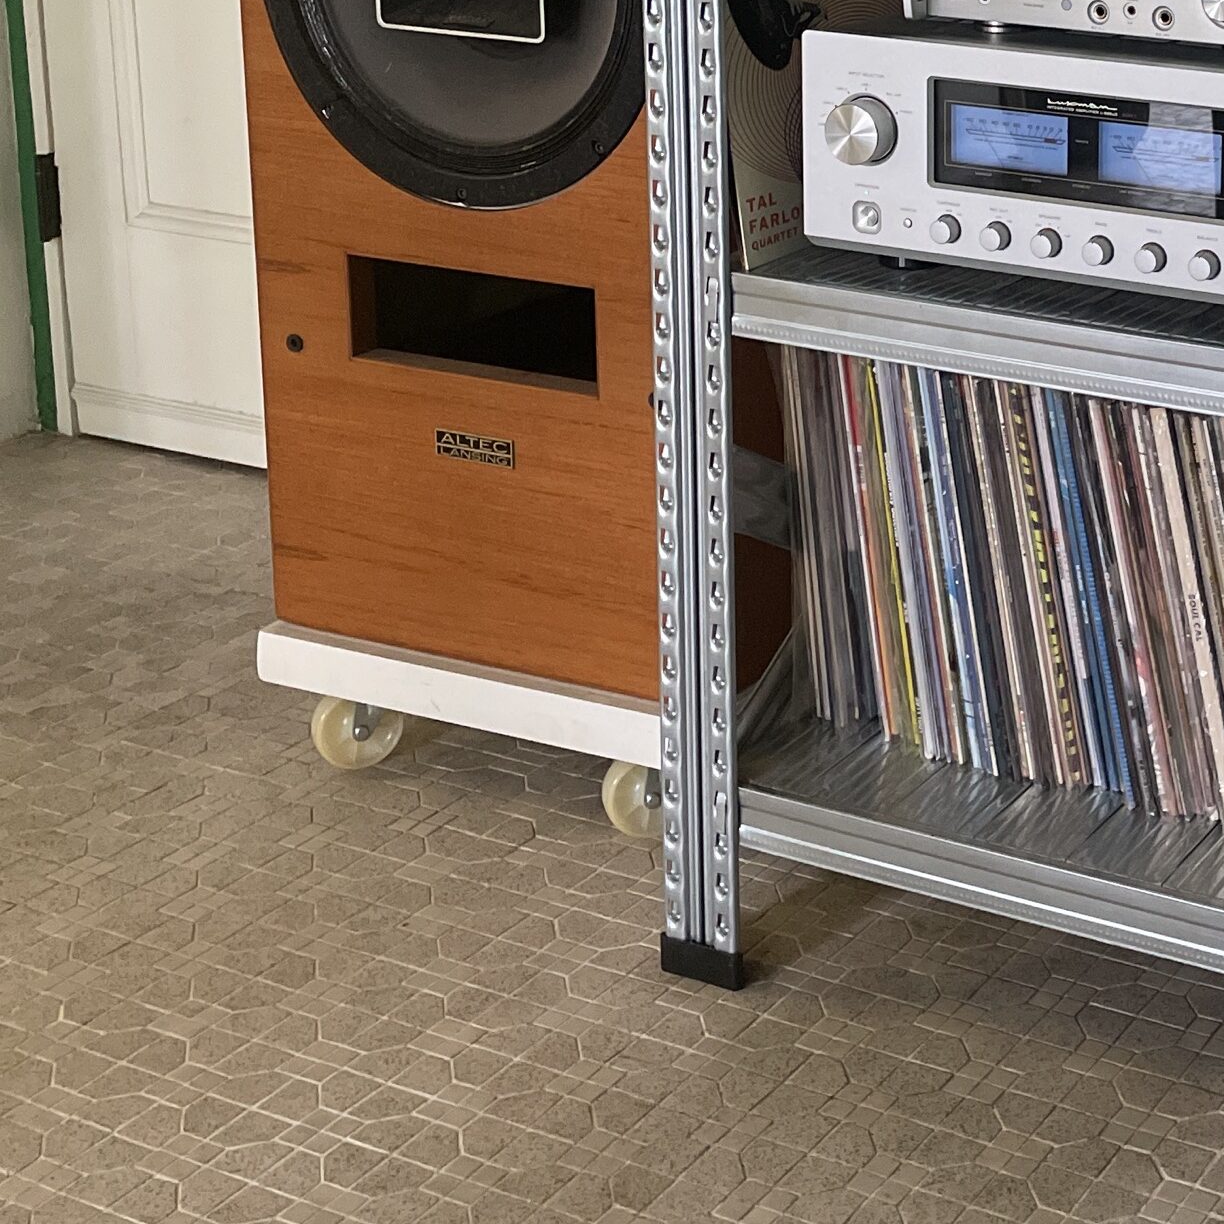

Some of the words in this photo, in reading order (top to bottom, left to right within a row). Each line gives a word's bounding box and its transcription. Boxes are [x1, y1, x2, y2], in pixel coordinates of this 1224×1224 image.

[746, 192, 777, 213] TAL
[749, 206, 801, 235] FARLO
[752, 227, 799, 251] QUARTET
[441, 433, 508, 454] ALTEC
[441, 447, 508, 466] LANSING
